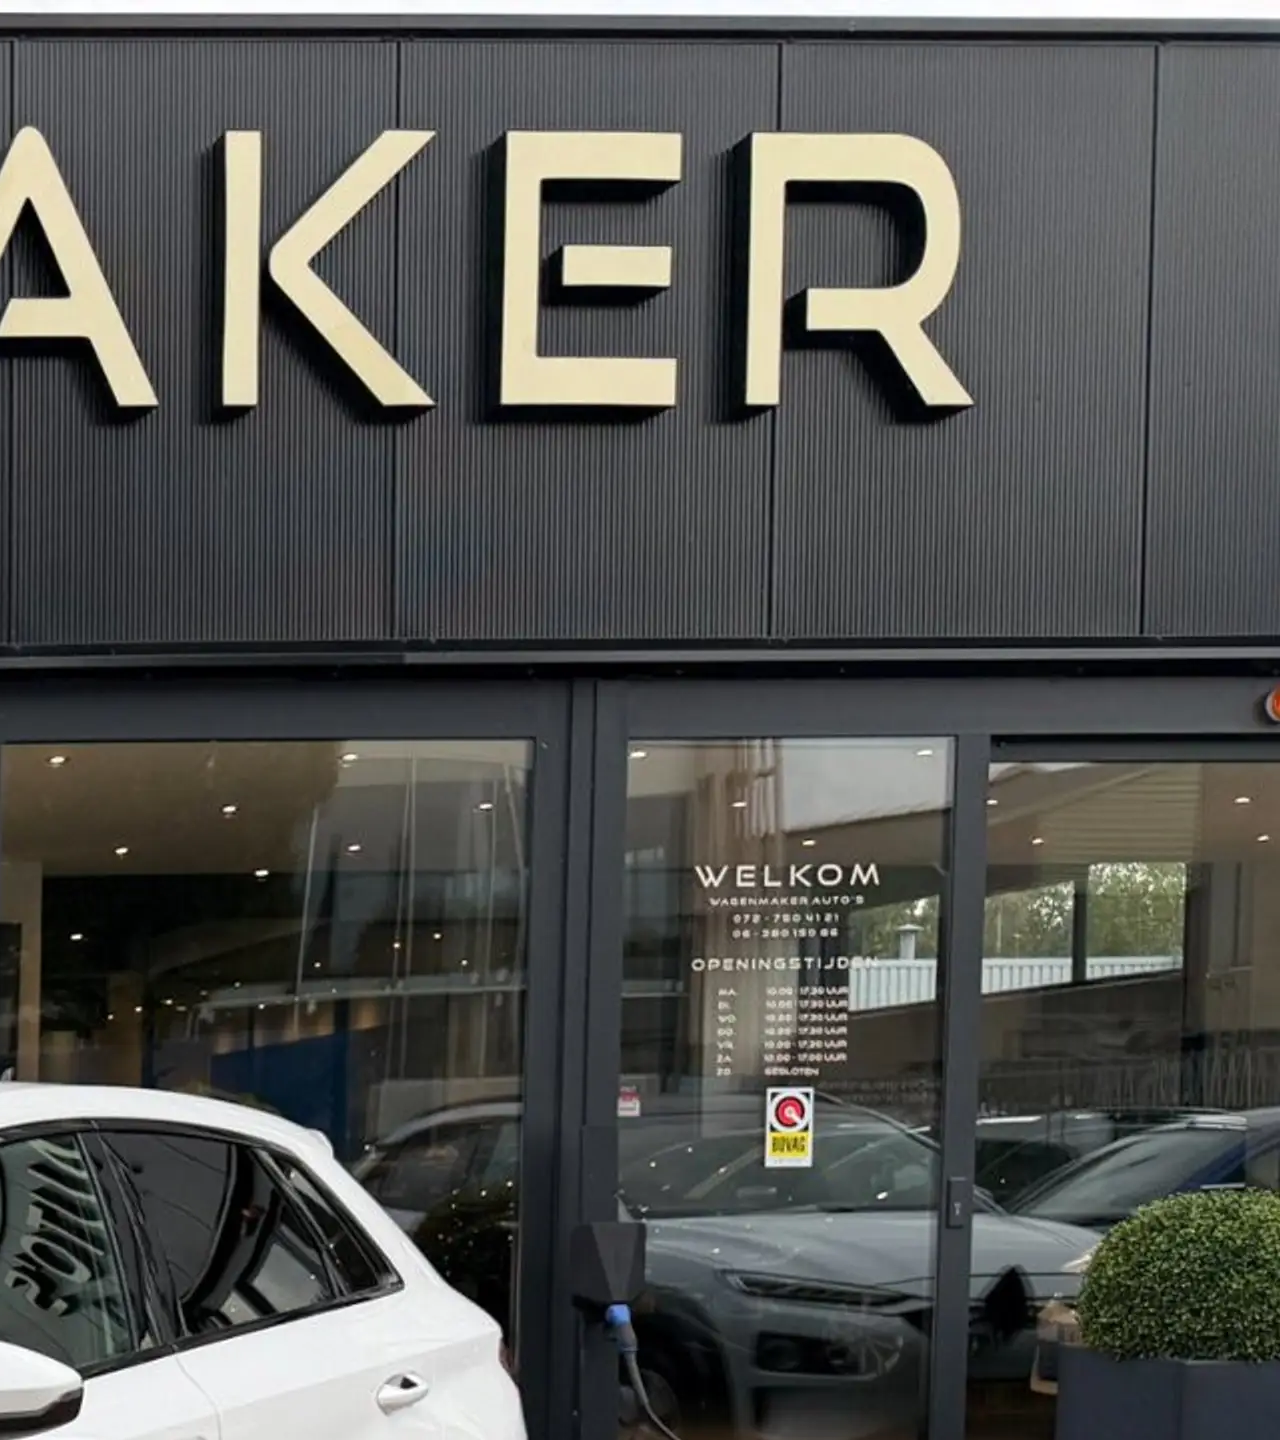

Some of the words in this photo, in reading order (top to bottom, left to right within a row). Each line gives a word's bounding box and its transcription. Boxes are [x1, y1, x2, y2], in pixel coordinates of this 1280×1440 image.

[694, 863, 880, 888] WELKOM
[691, 956, 880, 972] OPENINGSTIJDEN
[772, 1135, 806, 1153] BOVAG
